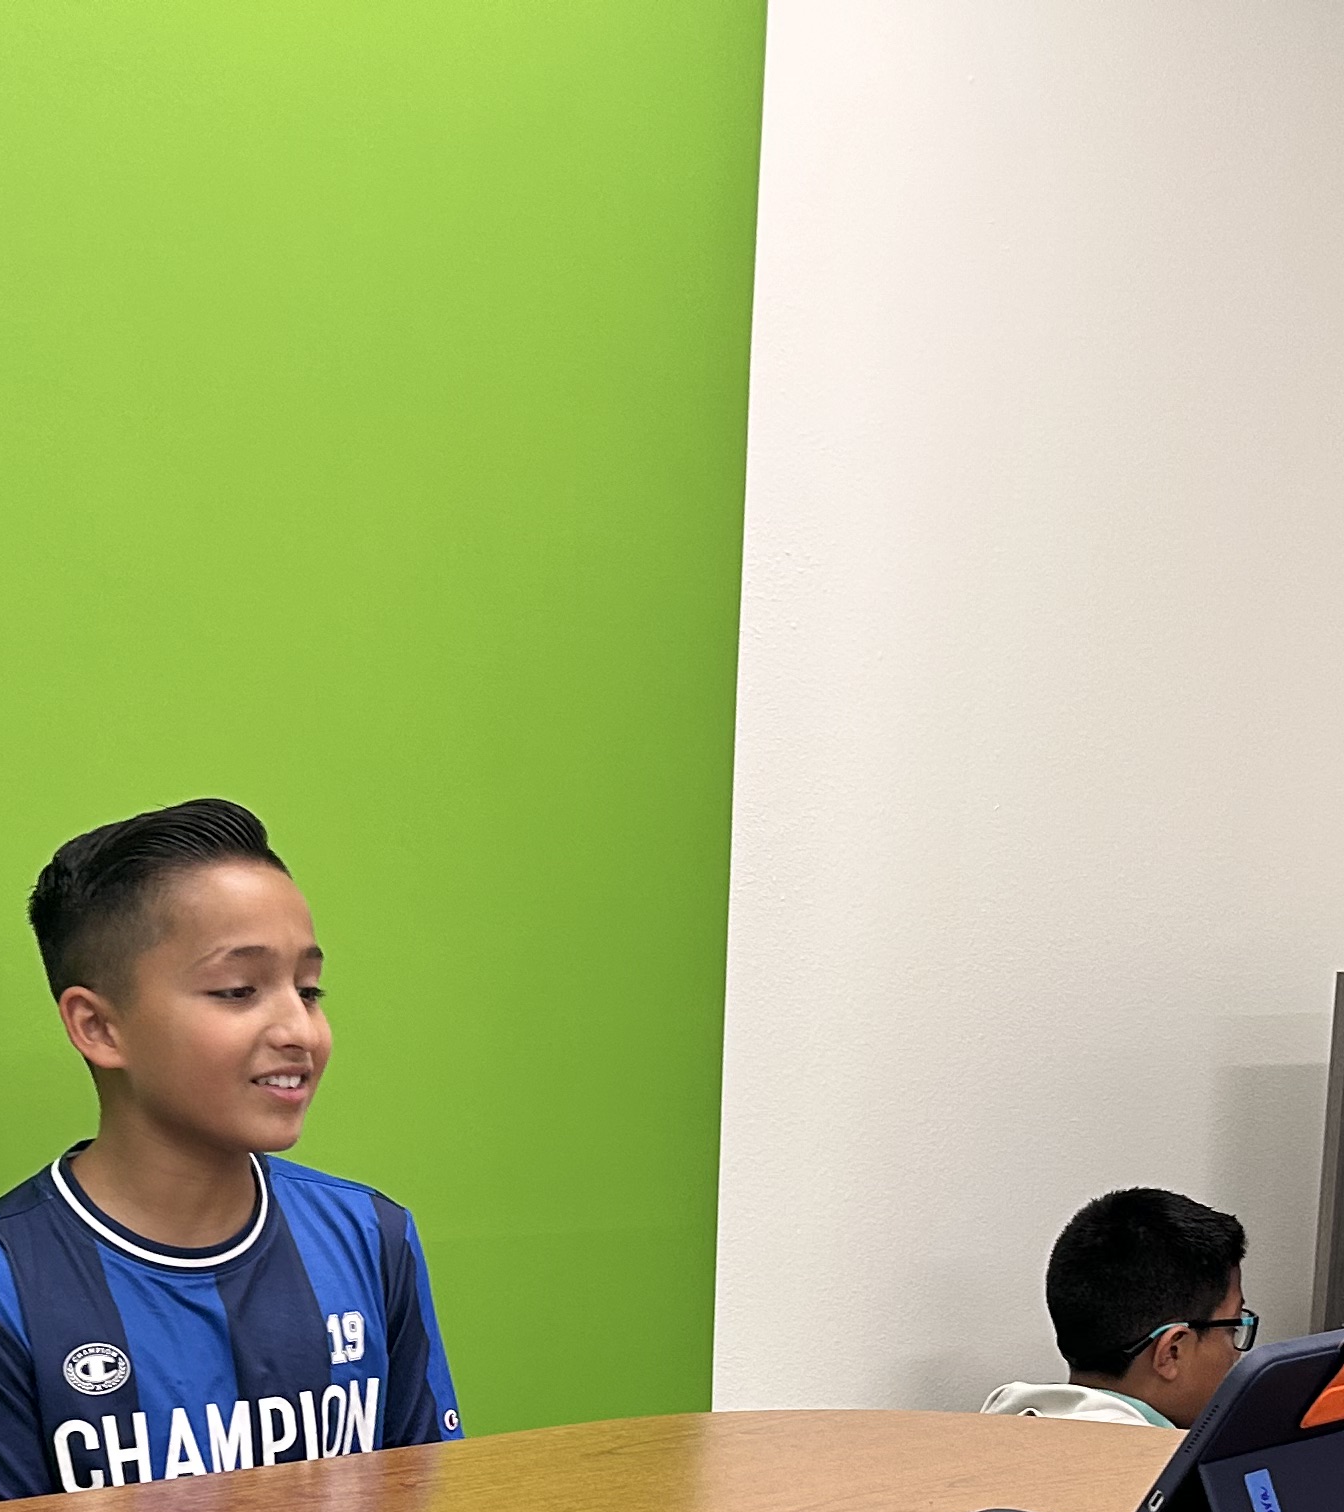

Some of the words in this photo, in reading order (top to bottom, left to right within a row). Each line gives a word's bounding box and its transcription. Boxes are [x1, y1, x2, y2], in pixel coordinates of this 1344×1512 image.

[72, 1347, 118, 1362] CHAMPION
[327, 1311, 365, 1365] 19
[53, 1377, 379, 1493] CHAMPION
